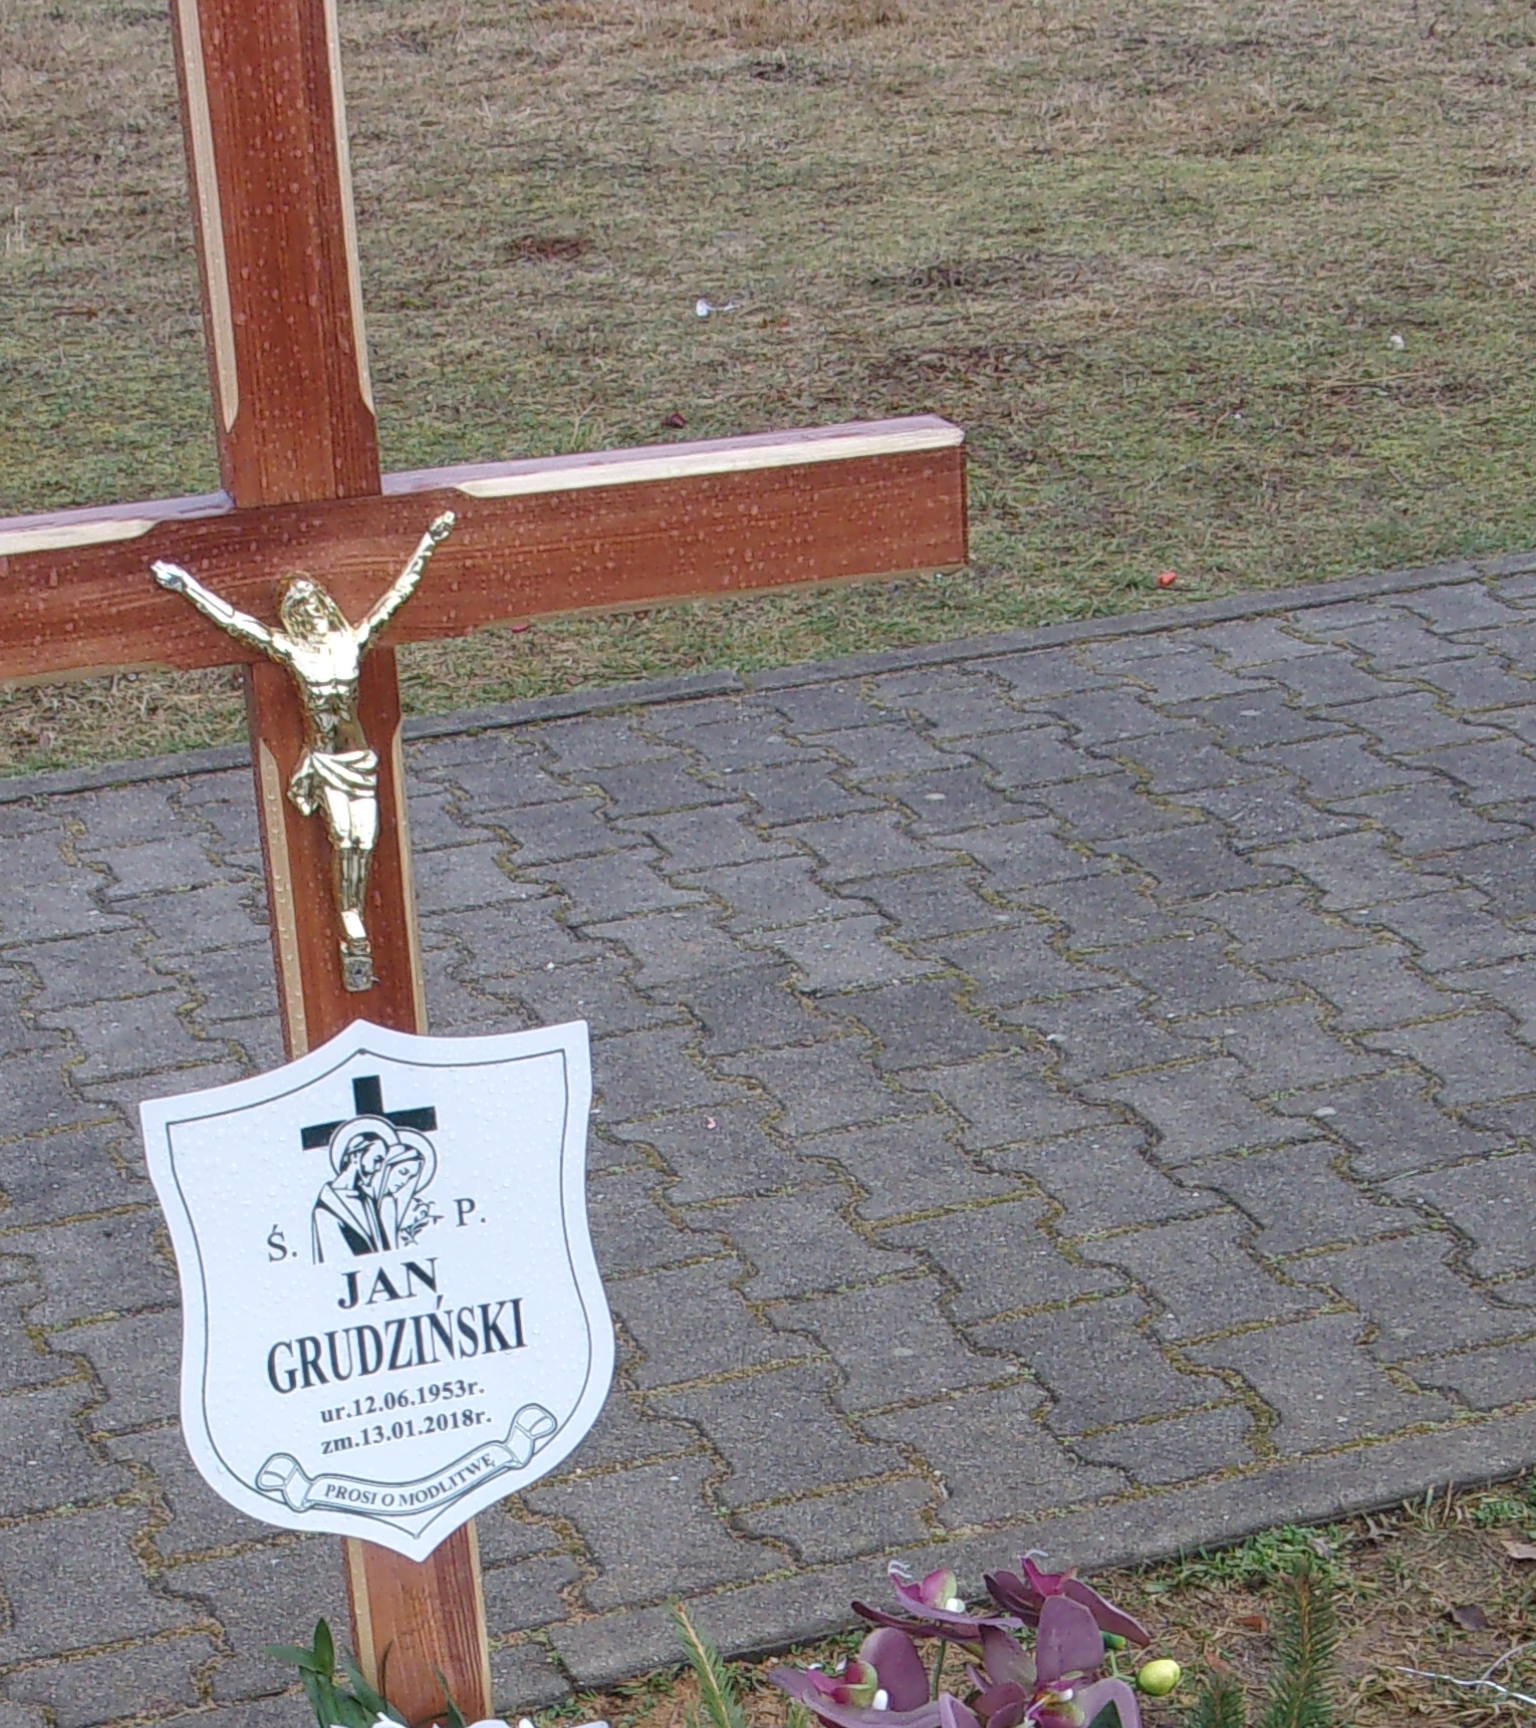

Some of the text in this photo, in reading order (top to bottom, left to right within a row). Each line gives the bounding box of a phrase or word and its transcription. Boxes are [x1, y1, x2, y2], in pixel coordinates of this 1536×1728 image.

[266, 1197, 487, 1263] Ś. P.
[337, 1256, 439, 1310] JAN
[266, 1294, 528, 1395] GRUDZIŃSKI
[320, 1379, 485, 1424] ur.12.06.1953r.
[320, 1408, 493, 1455] zm.13.01.2018r.
[324, 1452, 496, 1507] PROSI O MODLITWĘ
